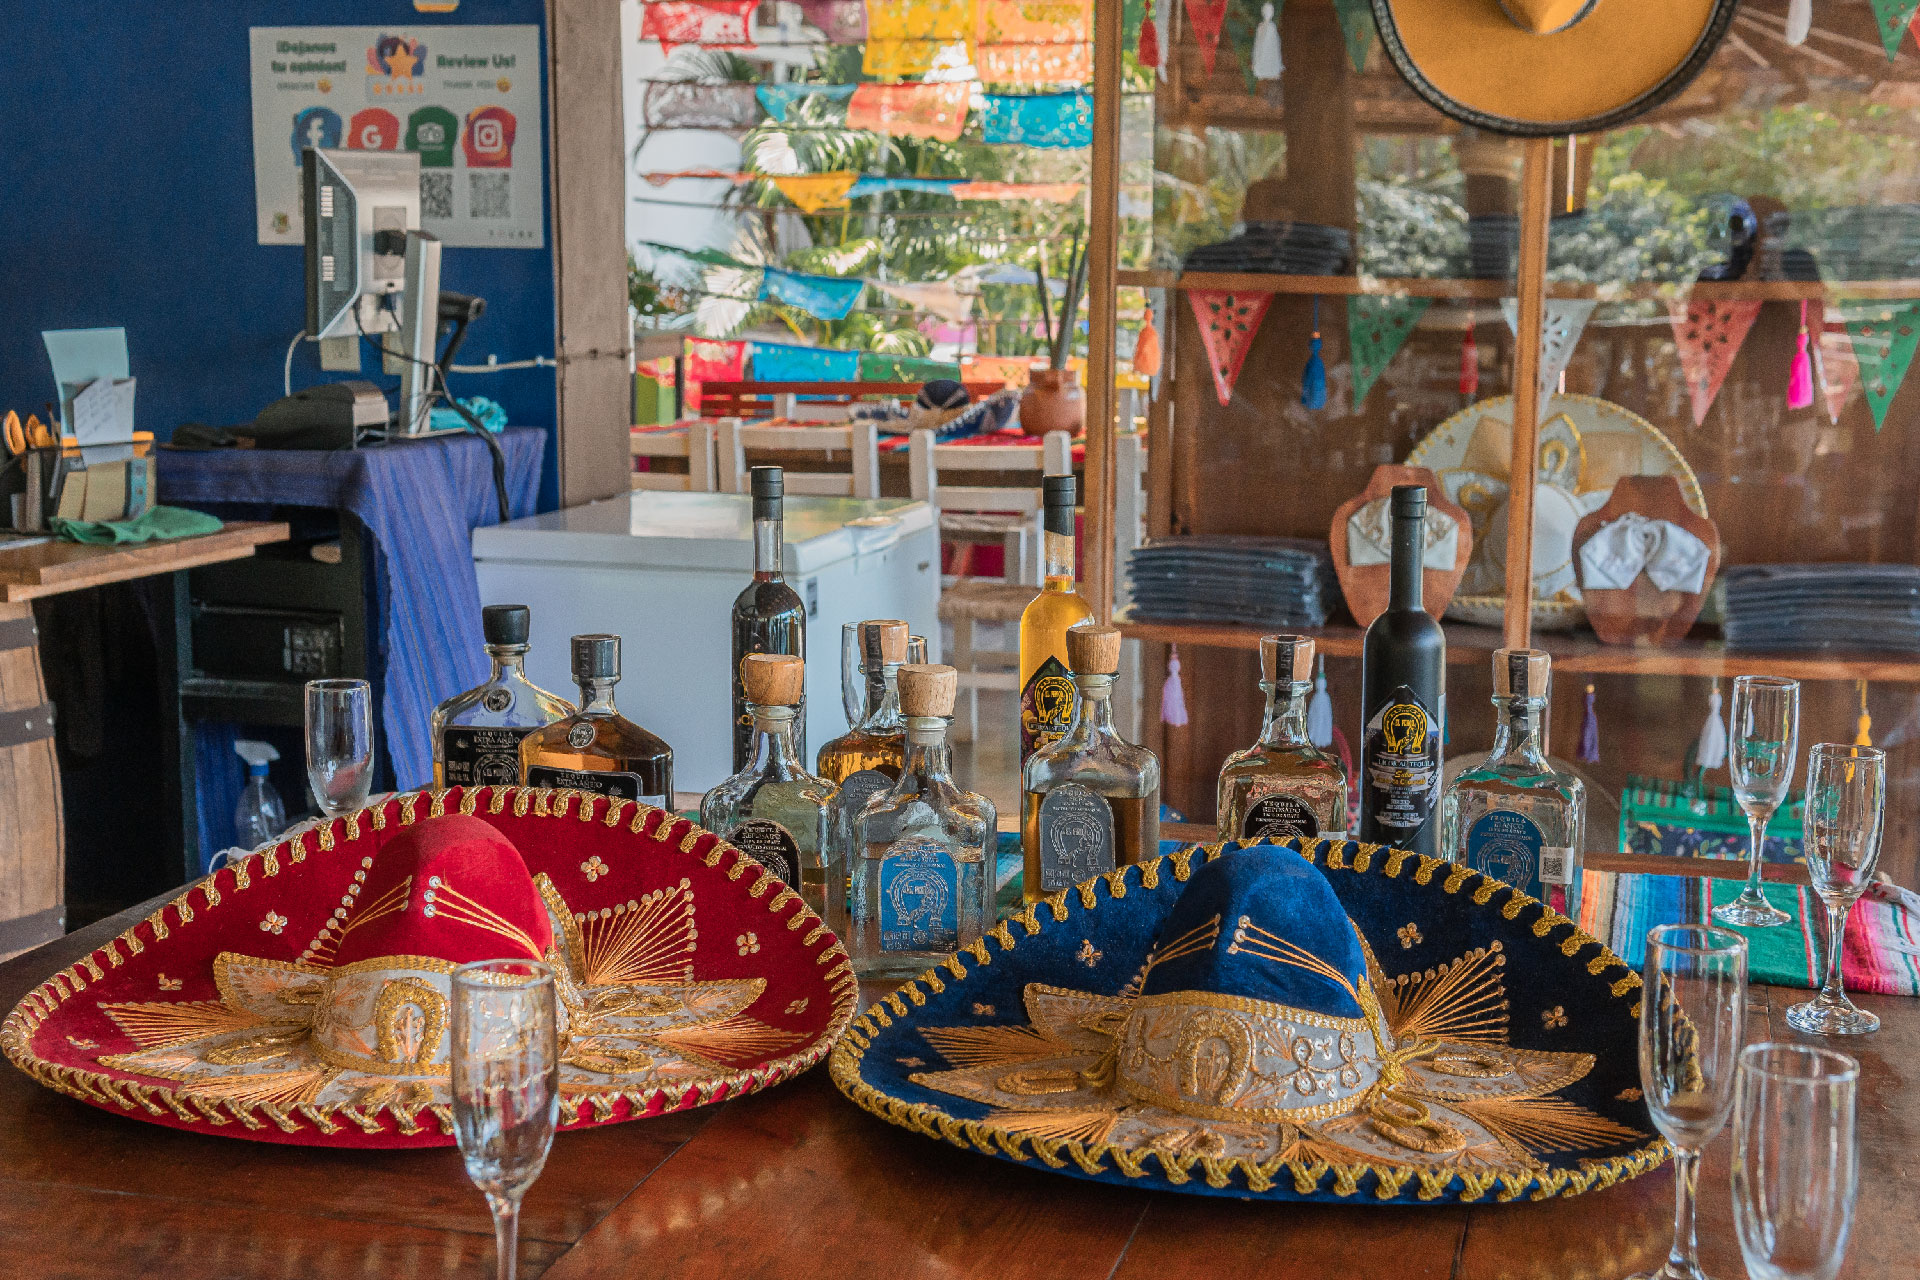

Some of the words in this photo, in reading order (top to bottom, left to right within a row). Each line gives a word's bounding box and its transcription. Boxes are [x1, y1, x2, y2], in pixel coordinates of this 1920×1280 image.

[436, 53, 489, 68] Review
[473, 736, 496, 745] EXTRA
[1410, 760, 1435, 768] TEQUILA
[560, 772, 596, 781] TEQUILA
[556, 777, 578, 787] EXTRA
[1489, 815, 1527, 824] TEQUILA
[1494, 821, 1525, 829] BLANCO
